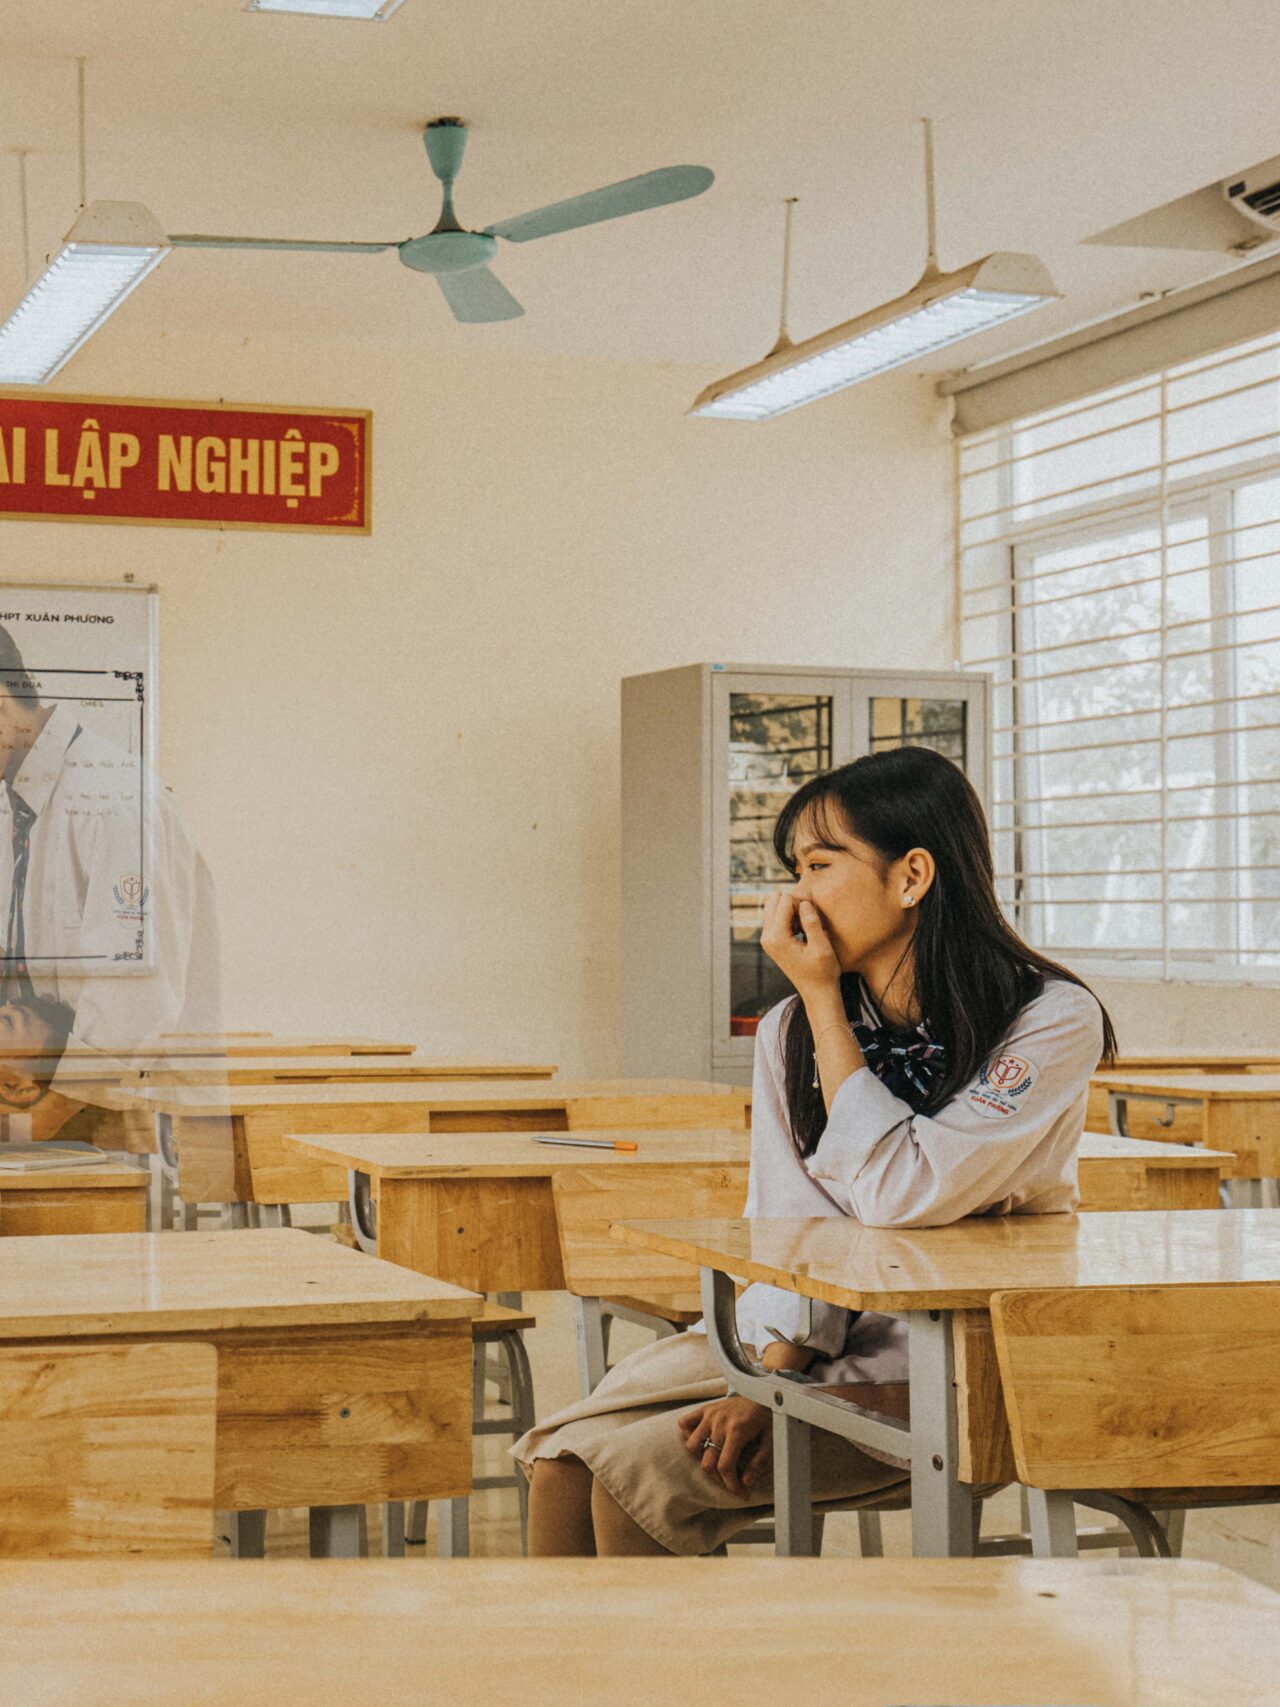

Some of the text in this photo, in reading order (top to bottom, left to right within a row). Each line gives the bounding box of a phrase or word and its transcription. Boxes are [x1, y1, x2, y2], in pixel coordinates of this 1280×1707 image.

[45, 418, 140, 500] LẬP
[158, 429, 339, 508] NGHIỆP
[25, 612, 60, 622] XUÂN
[64, 614, 115, 624] PHƯƠNG
